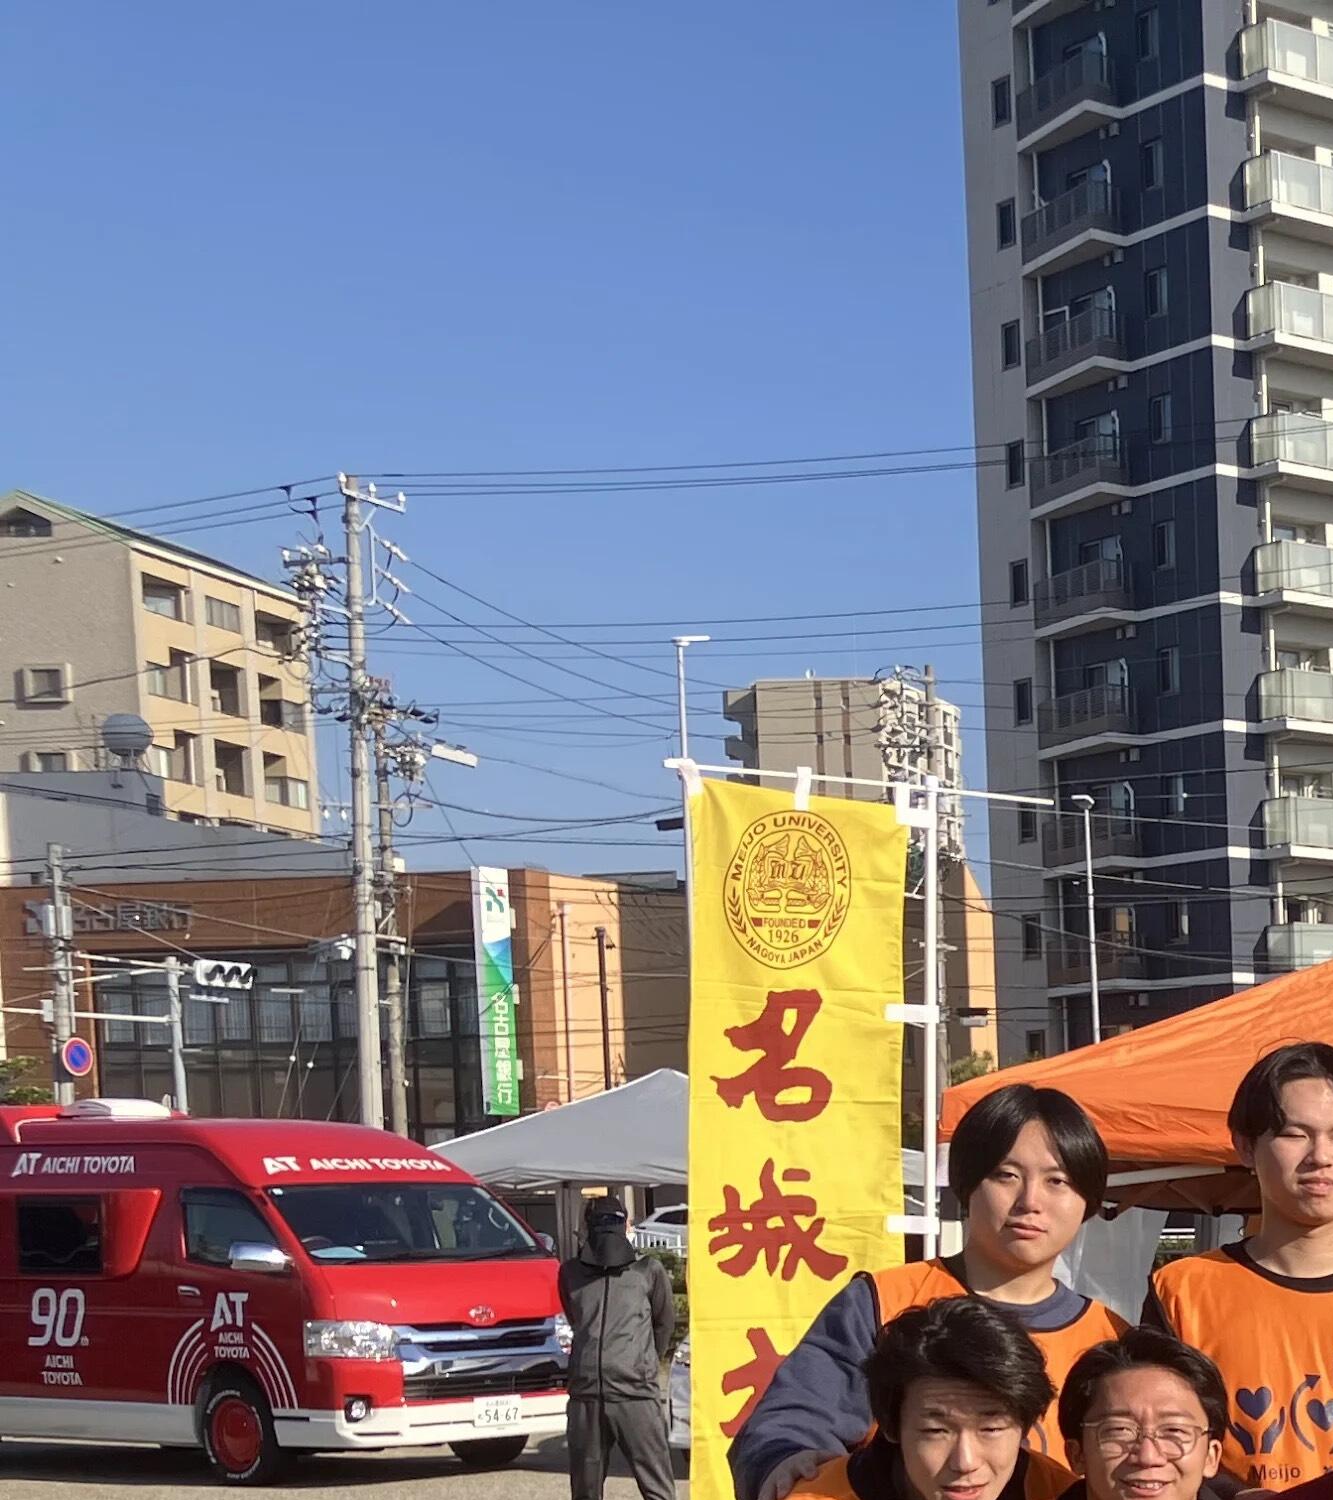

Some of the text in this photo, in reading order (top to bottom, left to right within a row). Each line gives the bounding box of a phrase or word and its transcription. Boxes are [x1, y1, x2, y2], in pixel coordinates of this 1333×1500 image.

[731, 815, 848, 889] MEIJO UNIVERSITY
[763, 918, 807, 928] FOUNDED
[768, 929, 799, 943] 1926
[746, 936, 824, 964] NAGOYA JAPAN
[11, 1153, 135, 1177] AT AICHI TOYOTA
[263, 1156, 452, 1175] AT AICHI TOYOTA
[210, 1292, 249, 1332] AT
[218, 1332, 243, 1344] AICHI
[213, 1345, 250, 1359] TOYOTA
[45, 1354, 74, 1369] AICHI
[41, 1370, 83, 1386] TOYOTA
[1247, 1464, 1301, 1482] Meijo
